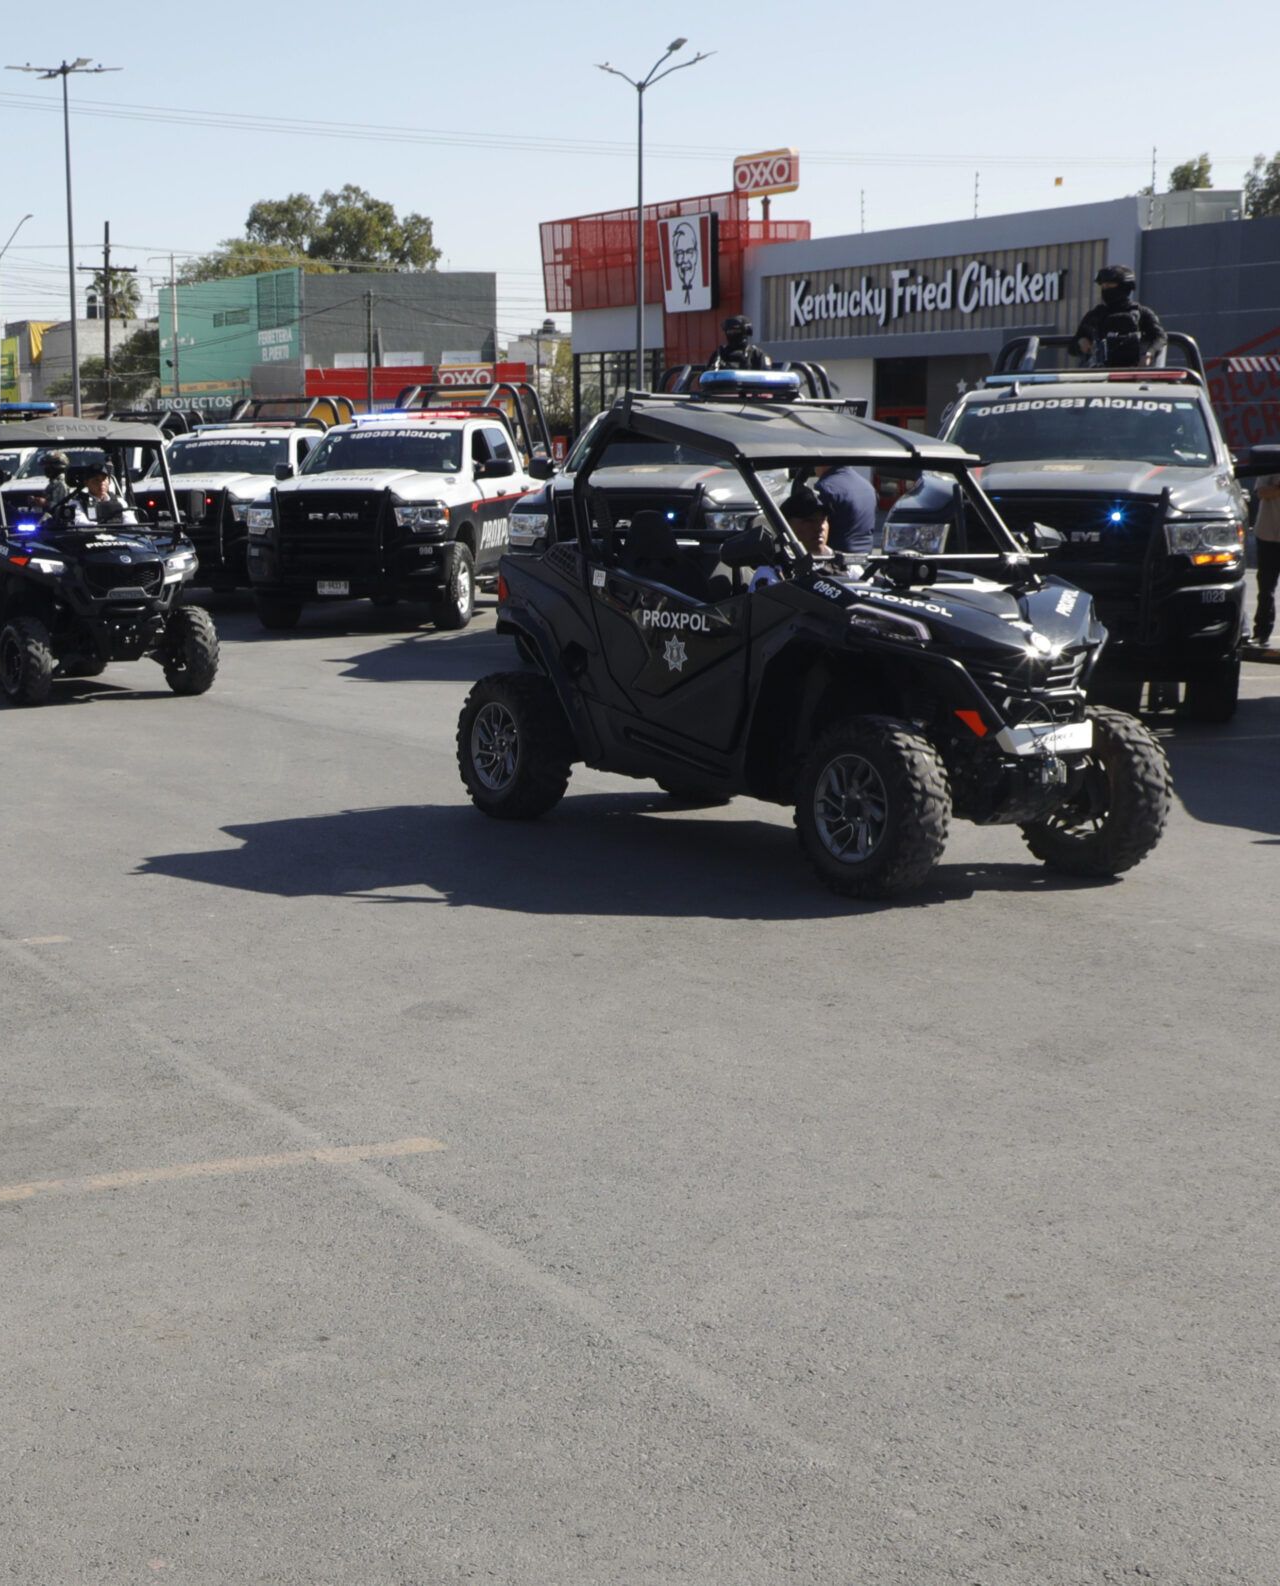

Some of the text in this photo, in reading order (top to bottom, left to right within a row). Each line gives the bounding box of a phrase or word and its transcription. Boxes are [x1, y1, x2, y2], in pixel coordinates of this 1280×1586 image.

[734, 156, 790, 191] OXXO
[789, 260, 1060, 327] Kentucky Fried Chicken
[440, 370, 492, 385] OXXO
[157, 396, 233, 411] PROYECTOS
[308, 512, 359, 521] RAM
[85, 540, 144, 549] PROXPOL
[813, 580, 843, 599] 0963
[1201, 590, 1226, 603] 1023
[642, 609, 711, 632] PROXPOL
